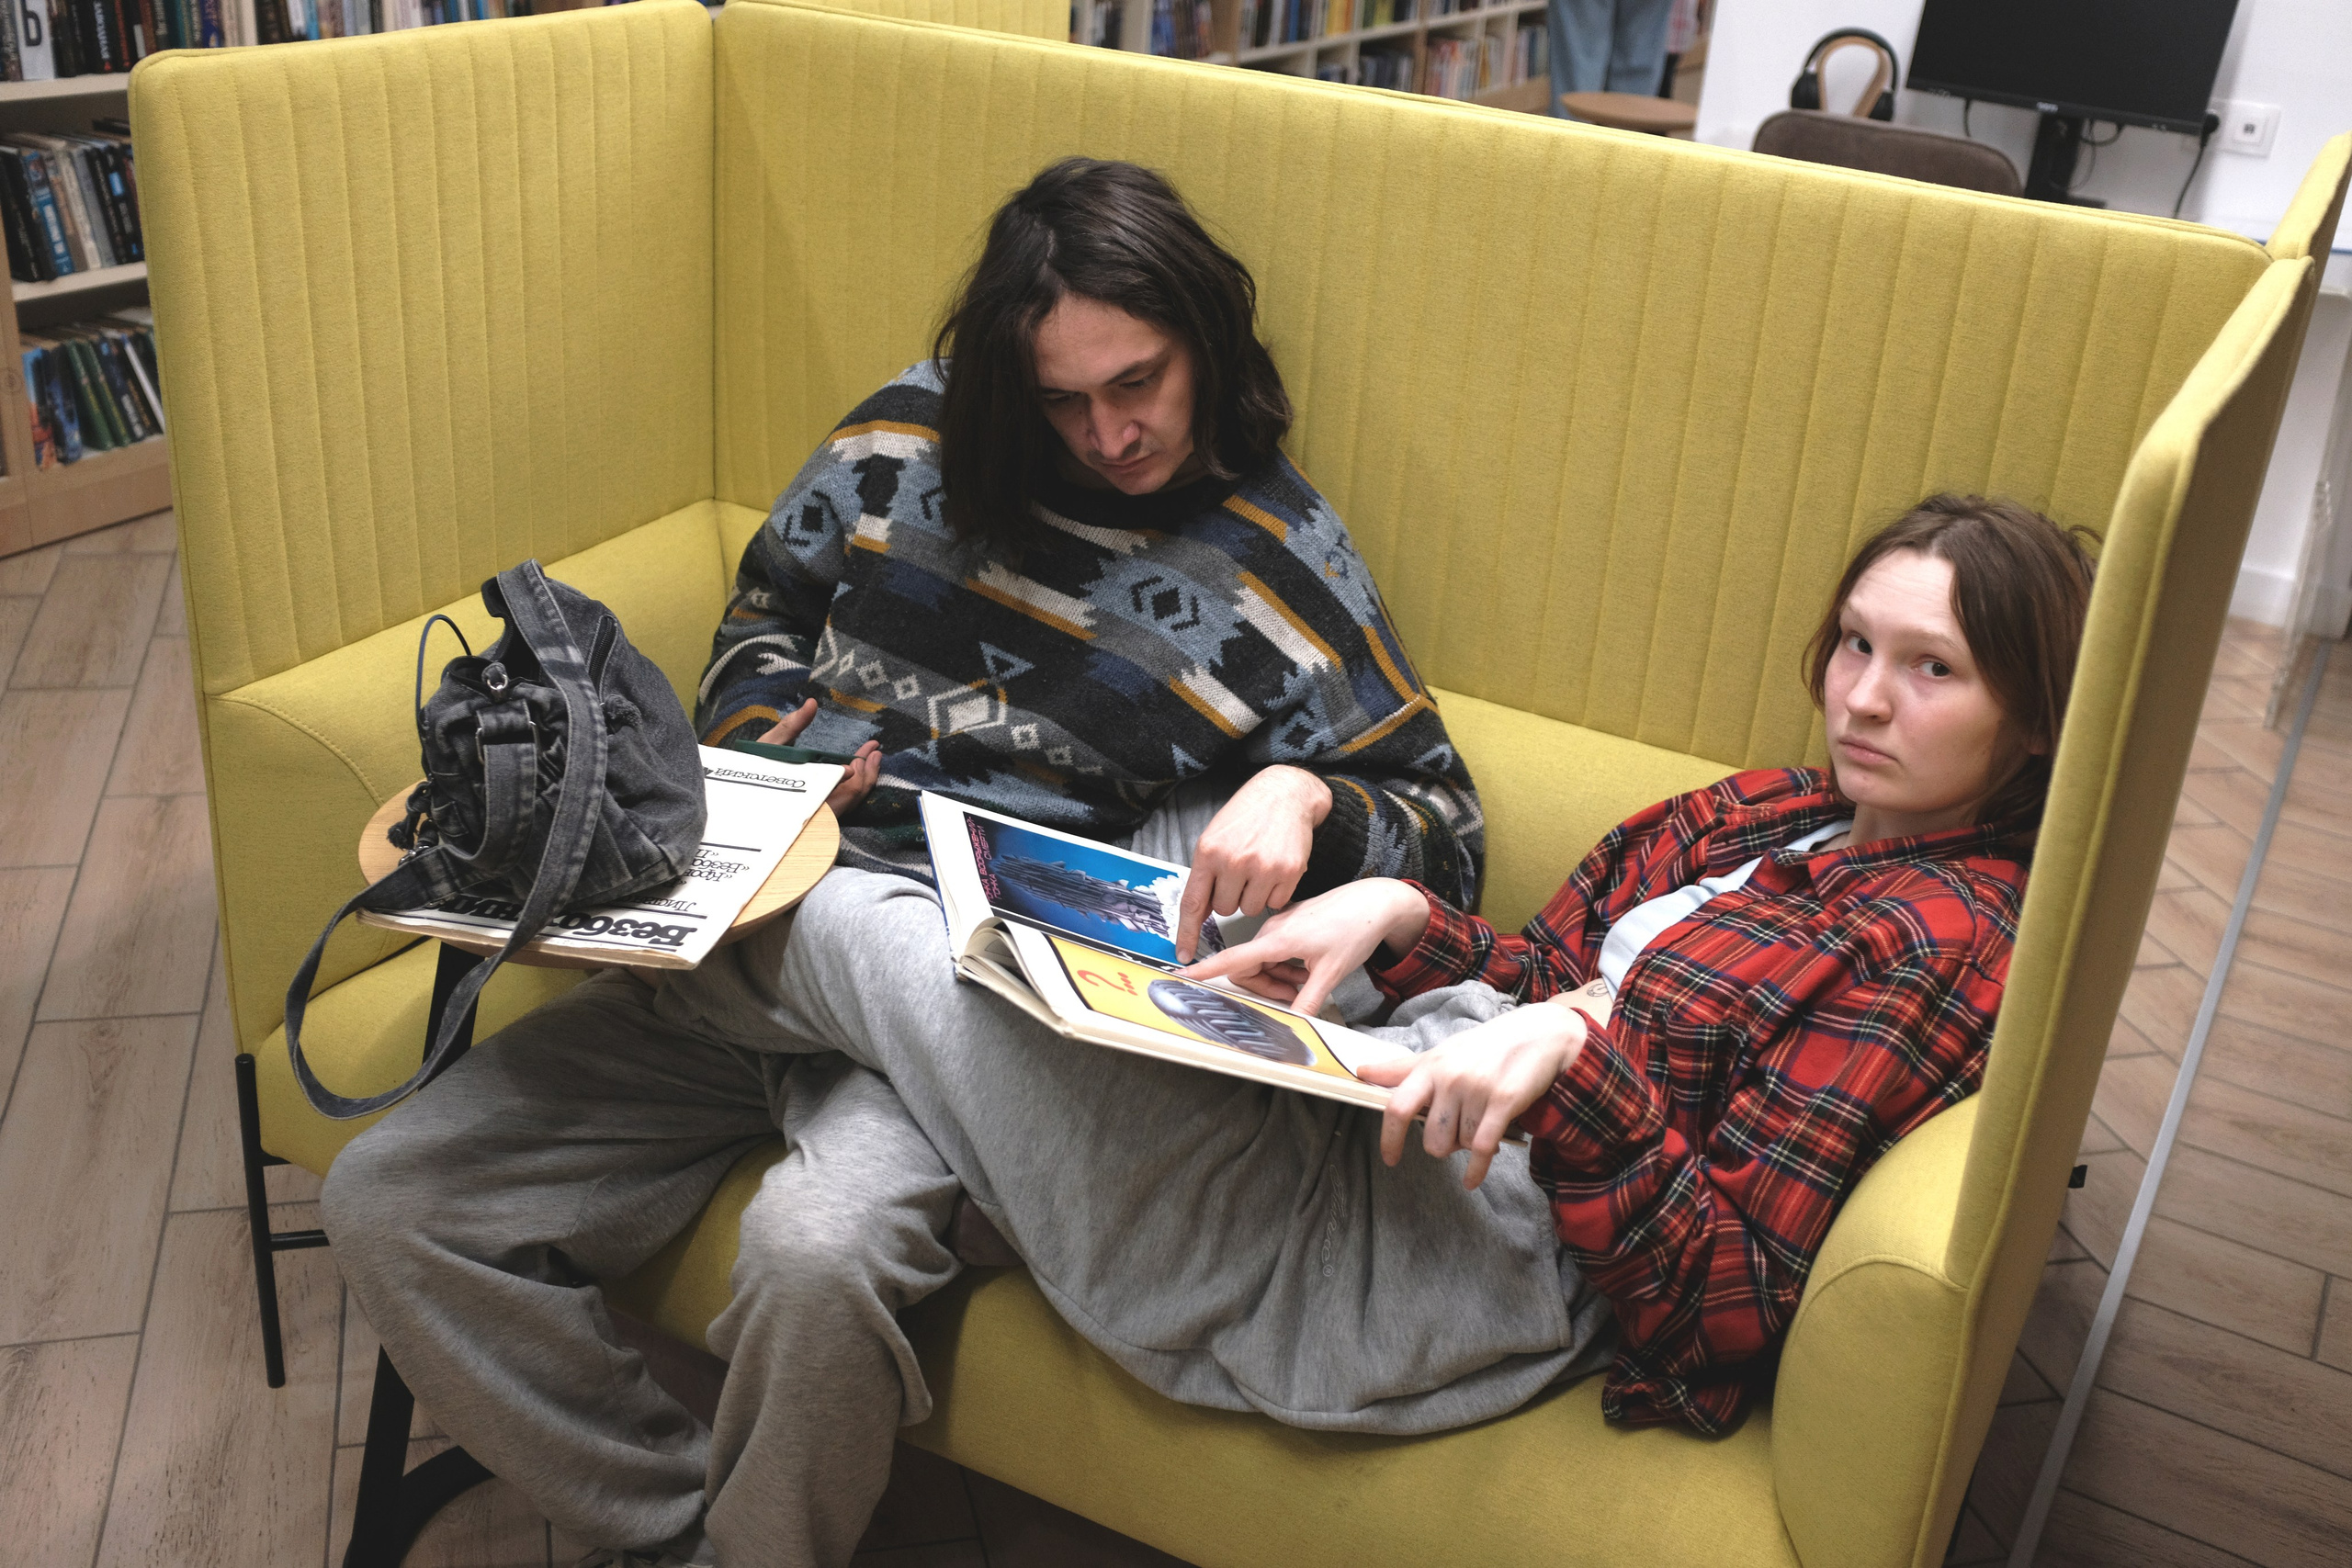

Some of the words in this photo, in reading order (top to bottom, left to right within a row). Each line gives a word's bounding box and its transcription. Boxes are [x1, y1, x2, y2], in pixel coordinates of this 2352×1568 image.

[714, 768, 806, 787] Советский
[977, 825, 992, 861] СМЕРТИ
[981, 878, 995, 904] ГОНКА
[989, 874, 1002, 899] ГОНКА
